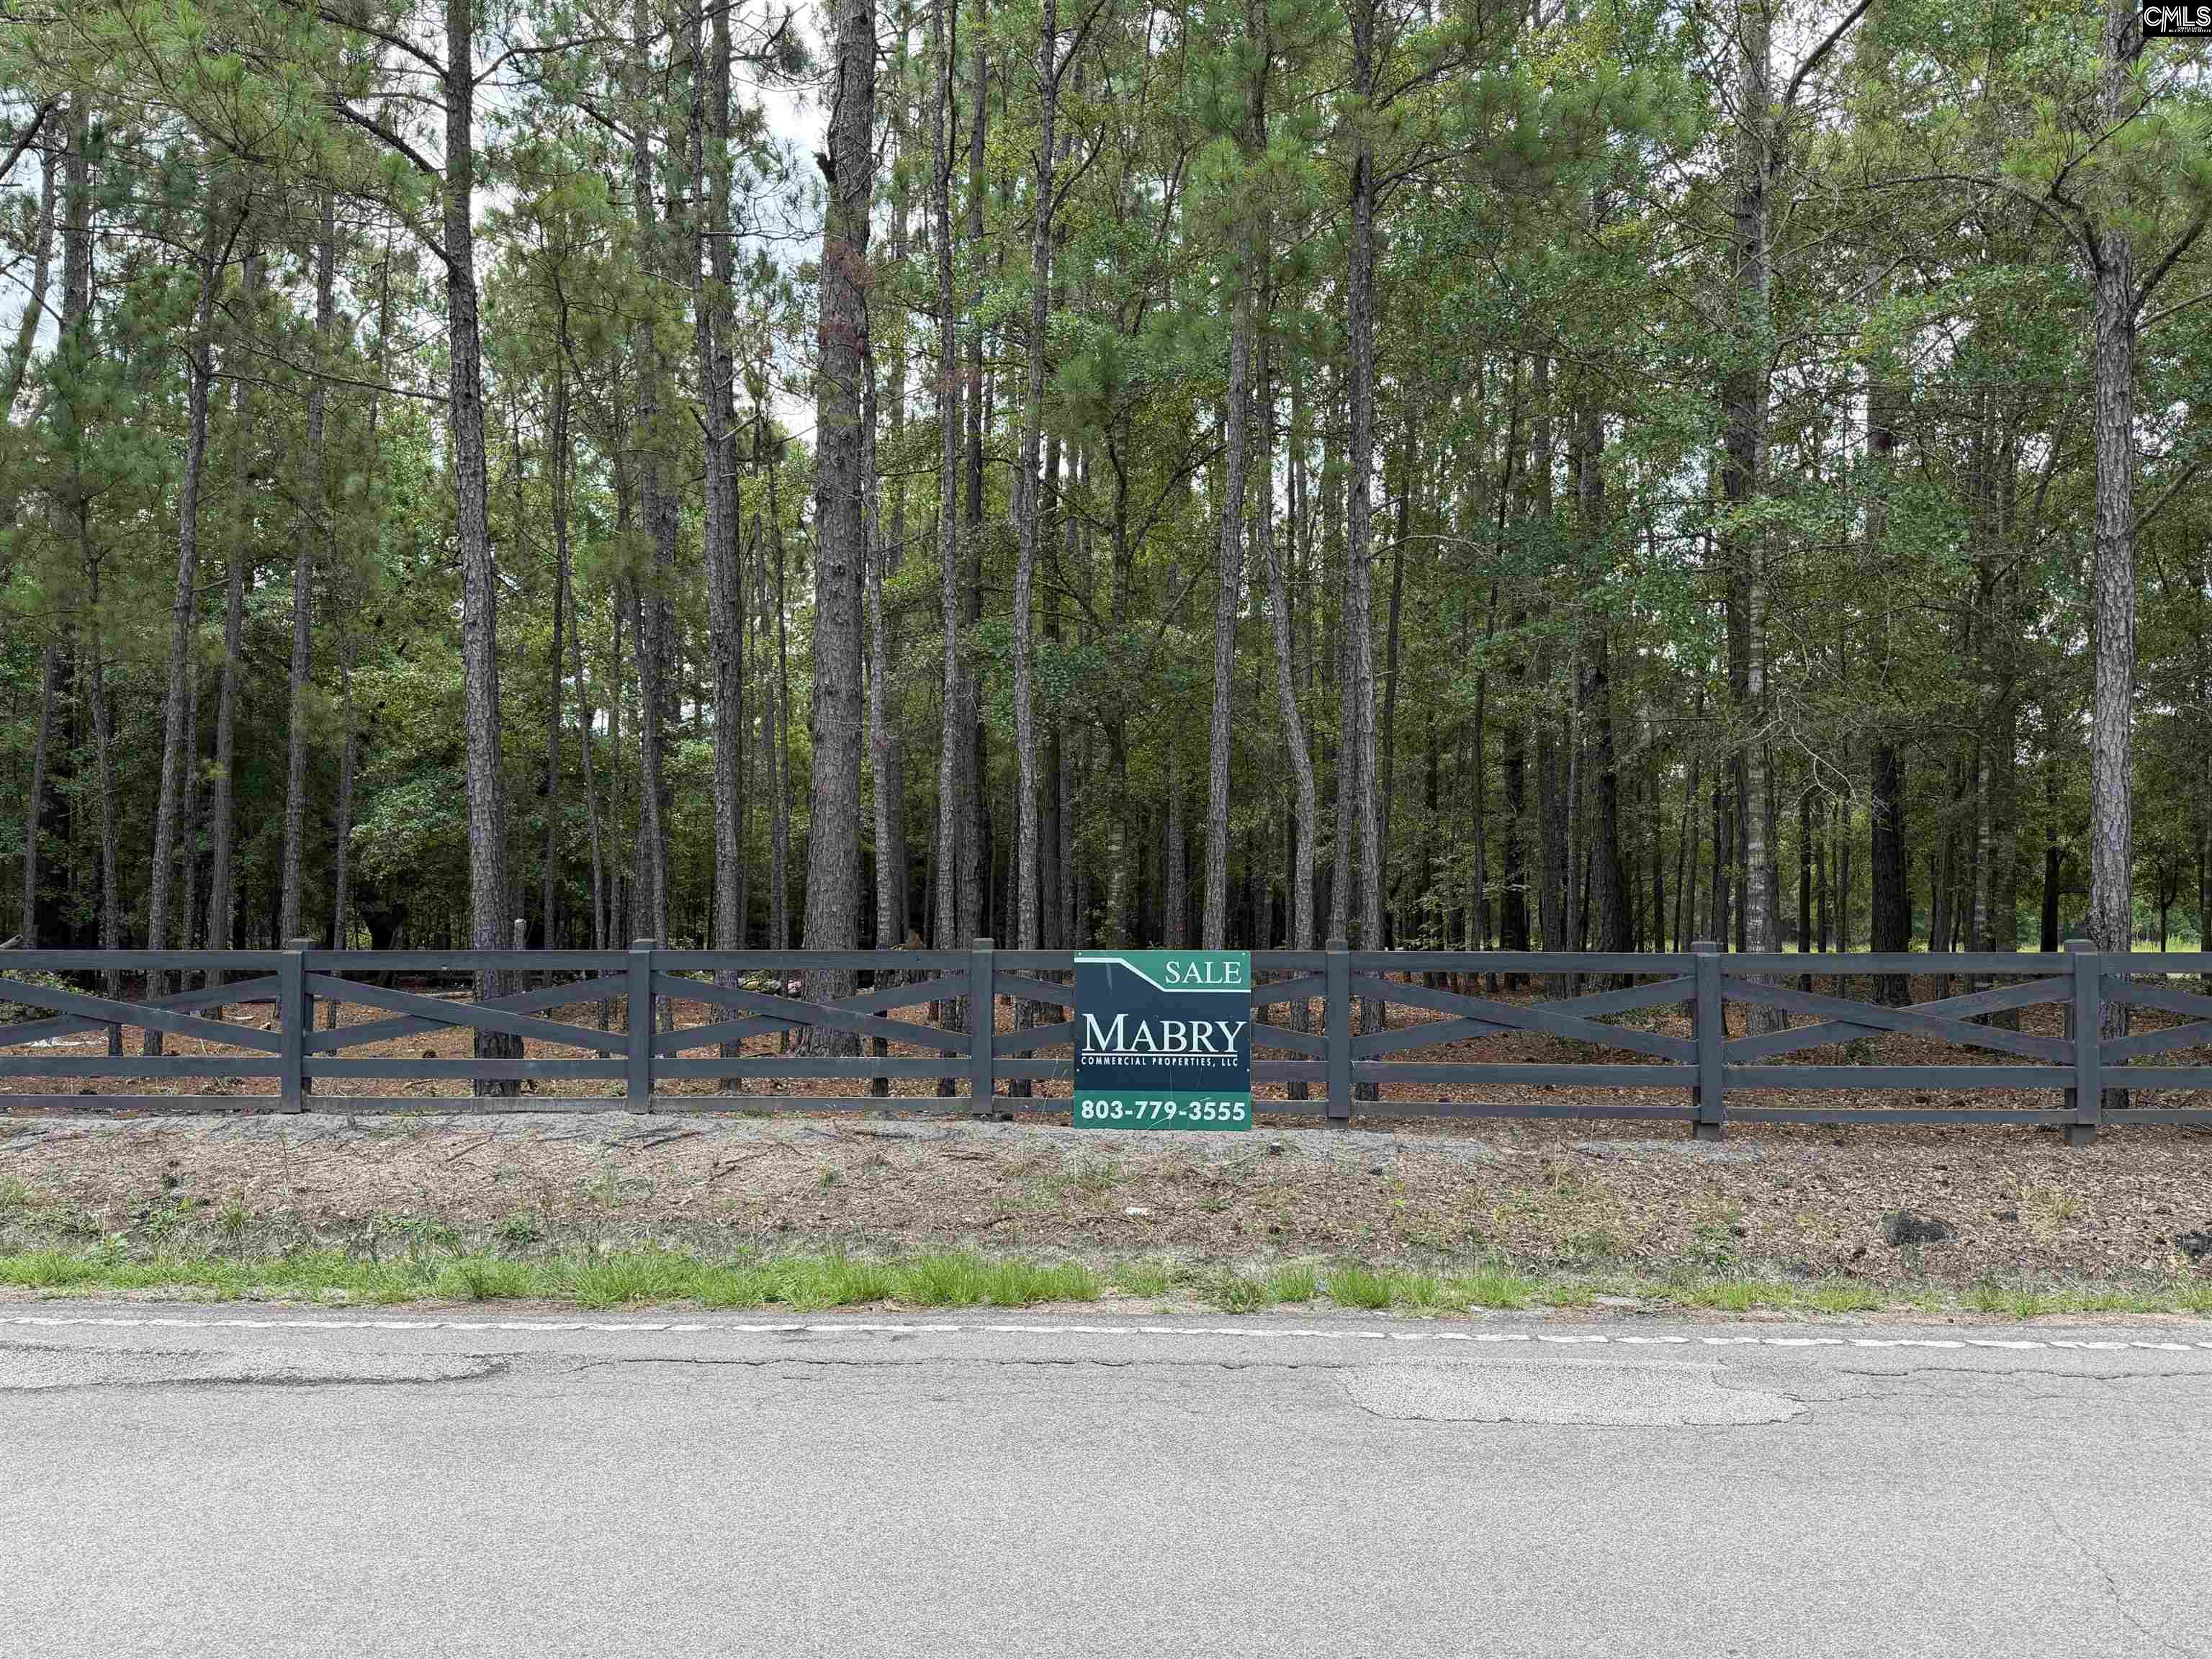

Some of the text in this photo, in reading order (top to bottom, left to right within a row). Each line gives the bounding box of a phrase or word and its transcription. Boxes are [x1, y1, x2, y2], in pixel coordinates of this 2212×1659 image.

[1165, 961, 1241, 984] SALE
[1081, 1013, 1248, 1052] MABRY
[1081, 1056, 1239, 1068] COMMERCIAL PROPERTIES, LLC
[1081, 1100, 1245, 1120] 803-779-3555
